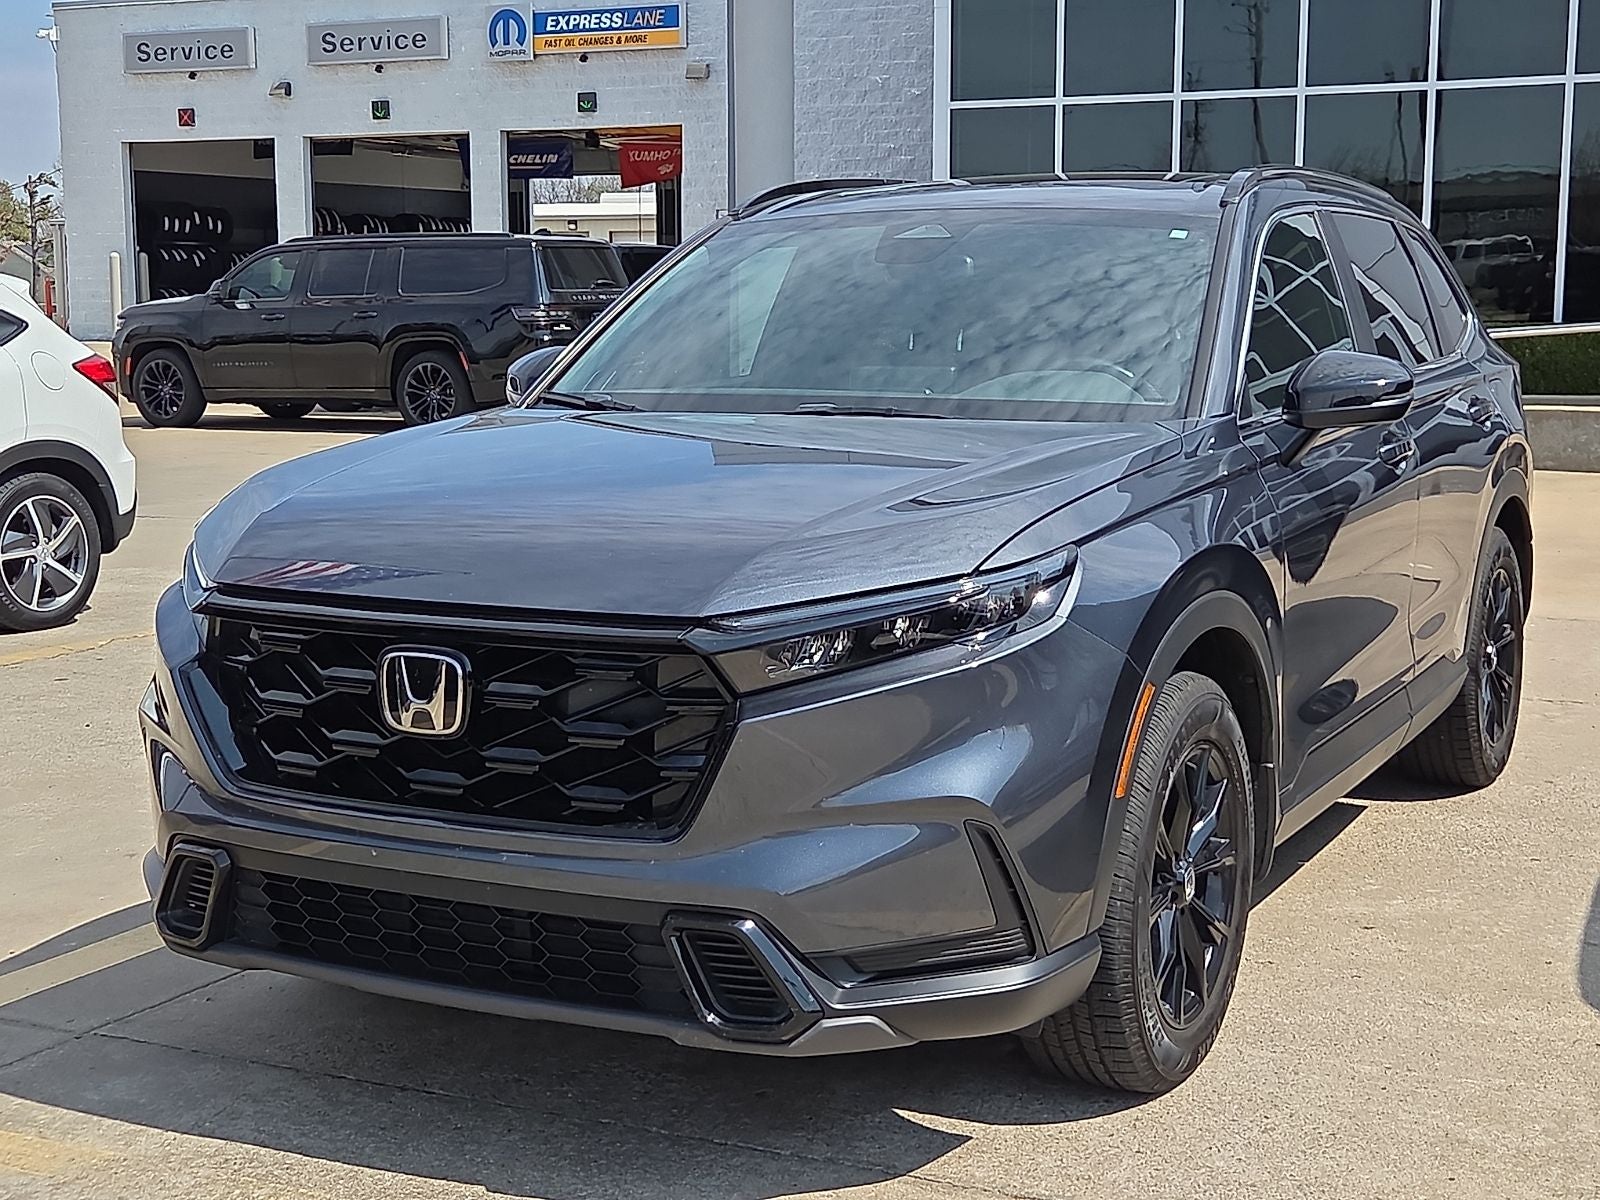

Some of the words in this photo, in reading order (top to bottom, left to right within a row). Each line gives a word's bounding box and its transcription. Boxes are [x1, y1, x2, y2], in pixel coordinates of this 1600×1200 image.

[546, 9, 666, 31] EXPRESSLANE
[321, 29, 427, 53] Service
[544, 38, 563, 48] FAST
[564, 38, 576, 47] OIL
[578, 35, 615, 47] CHANGES
[616, 36, 623, 45] &
[624, 34, 649, 44] MORE
[136, 40, 234, 62] Service
[489, 48, 527, 57] MOPAR
[628, 149, 671, 162] KUMHO
